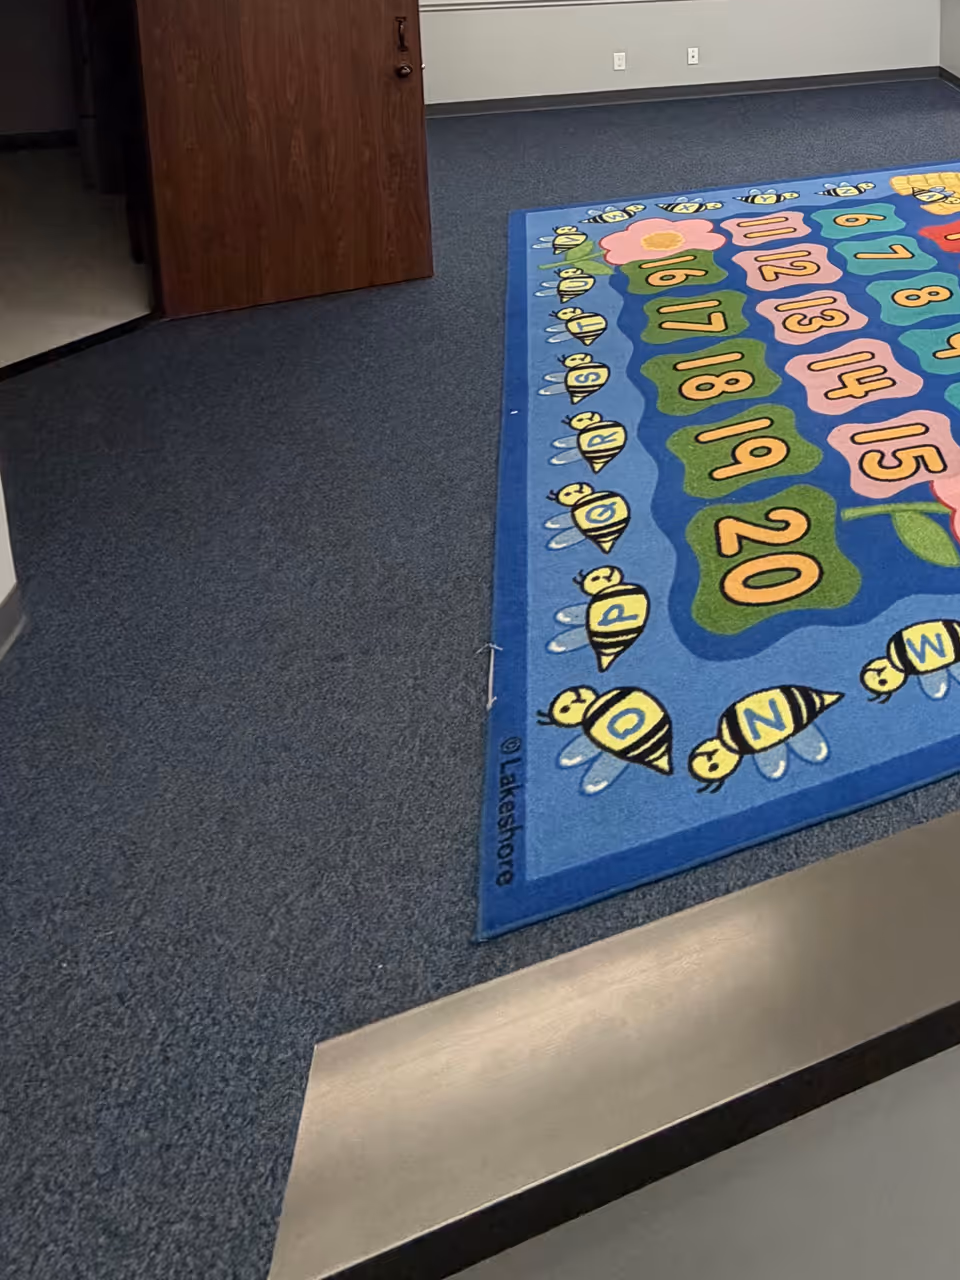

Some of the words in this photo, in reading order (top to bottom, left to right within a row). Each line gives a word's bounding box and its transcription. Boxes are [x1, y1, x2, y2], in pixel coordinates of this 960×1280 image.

[735, 216, 797, 238] 11
[833, 212, 887, 228] 6
[754, 249, 821, 283] 12
[853, 243, 915, 261] 7
[564, 279, 589, 289] U
[639, 253, 709, 288] 16
[891, 284, 953, 309] 8
[576, 321, 604, 332] T
[657, 298, 728, 334] 17
[774, 295, 850, 336] 13
[574, 371, 601, 384] S
[673, 351, 756, 403] 18
[807, 350, 896, 402] 14
[587, 431, 619, 448] R
[695, 416, 789, 482] 19
[850, 422, 947, 483] 15
[585, 501, 617, 524] Q
[714, 506, 822, 607] 20
[597, 603, 640, 627] P
[742, 698, 787, 741] N
